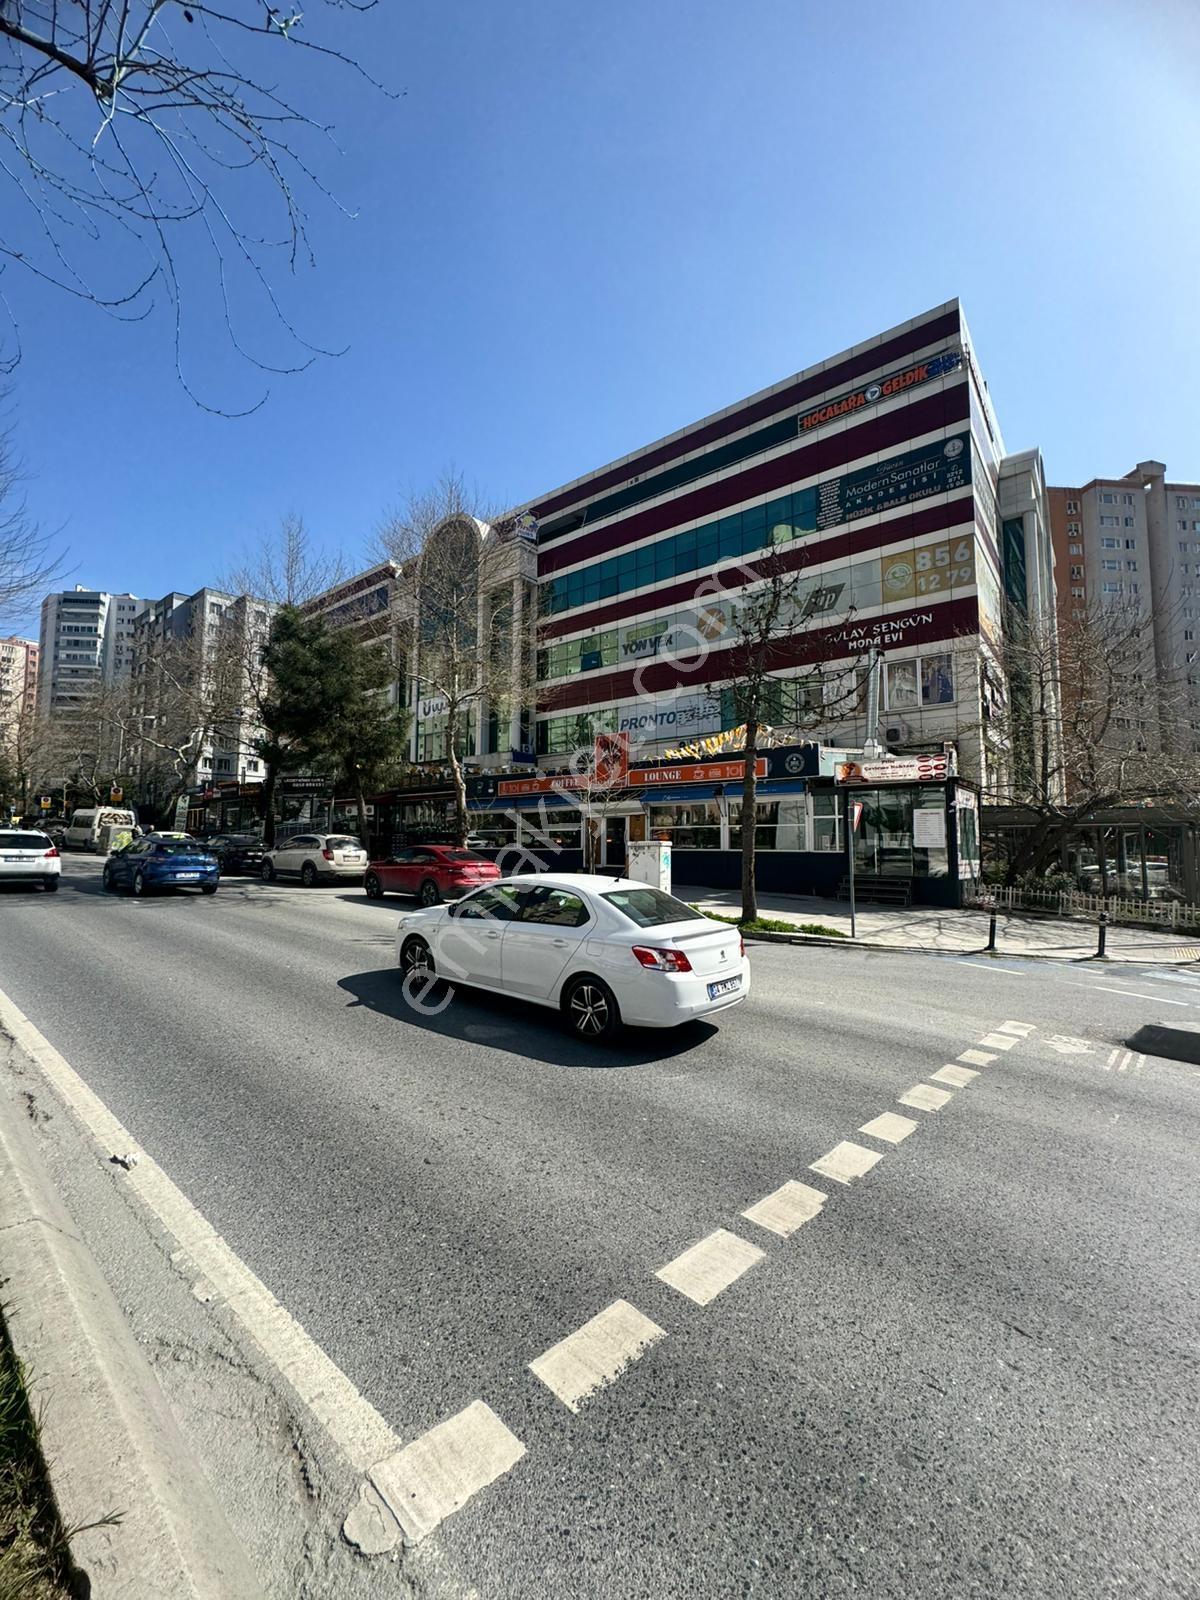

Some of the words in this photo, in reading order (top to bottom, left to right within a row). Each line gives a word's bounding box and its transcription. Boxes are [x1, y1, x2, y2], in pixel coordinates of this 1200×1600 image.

[802, 392, 866, 429] HOCALARA
[881, 365, 929, 395] GELDİK
[908, 485, 941, 500] OKULU
[916, 541, 971, 572] 856
[872, 613, 933, 636] ŞENGÜN
[884, 630, 903, 644] EVİ
[644, 770, 682, 782] LOUNGE
